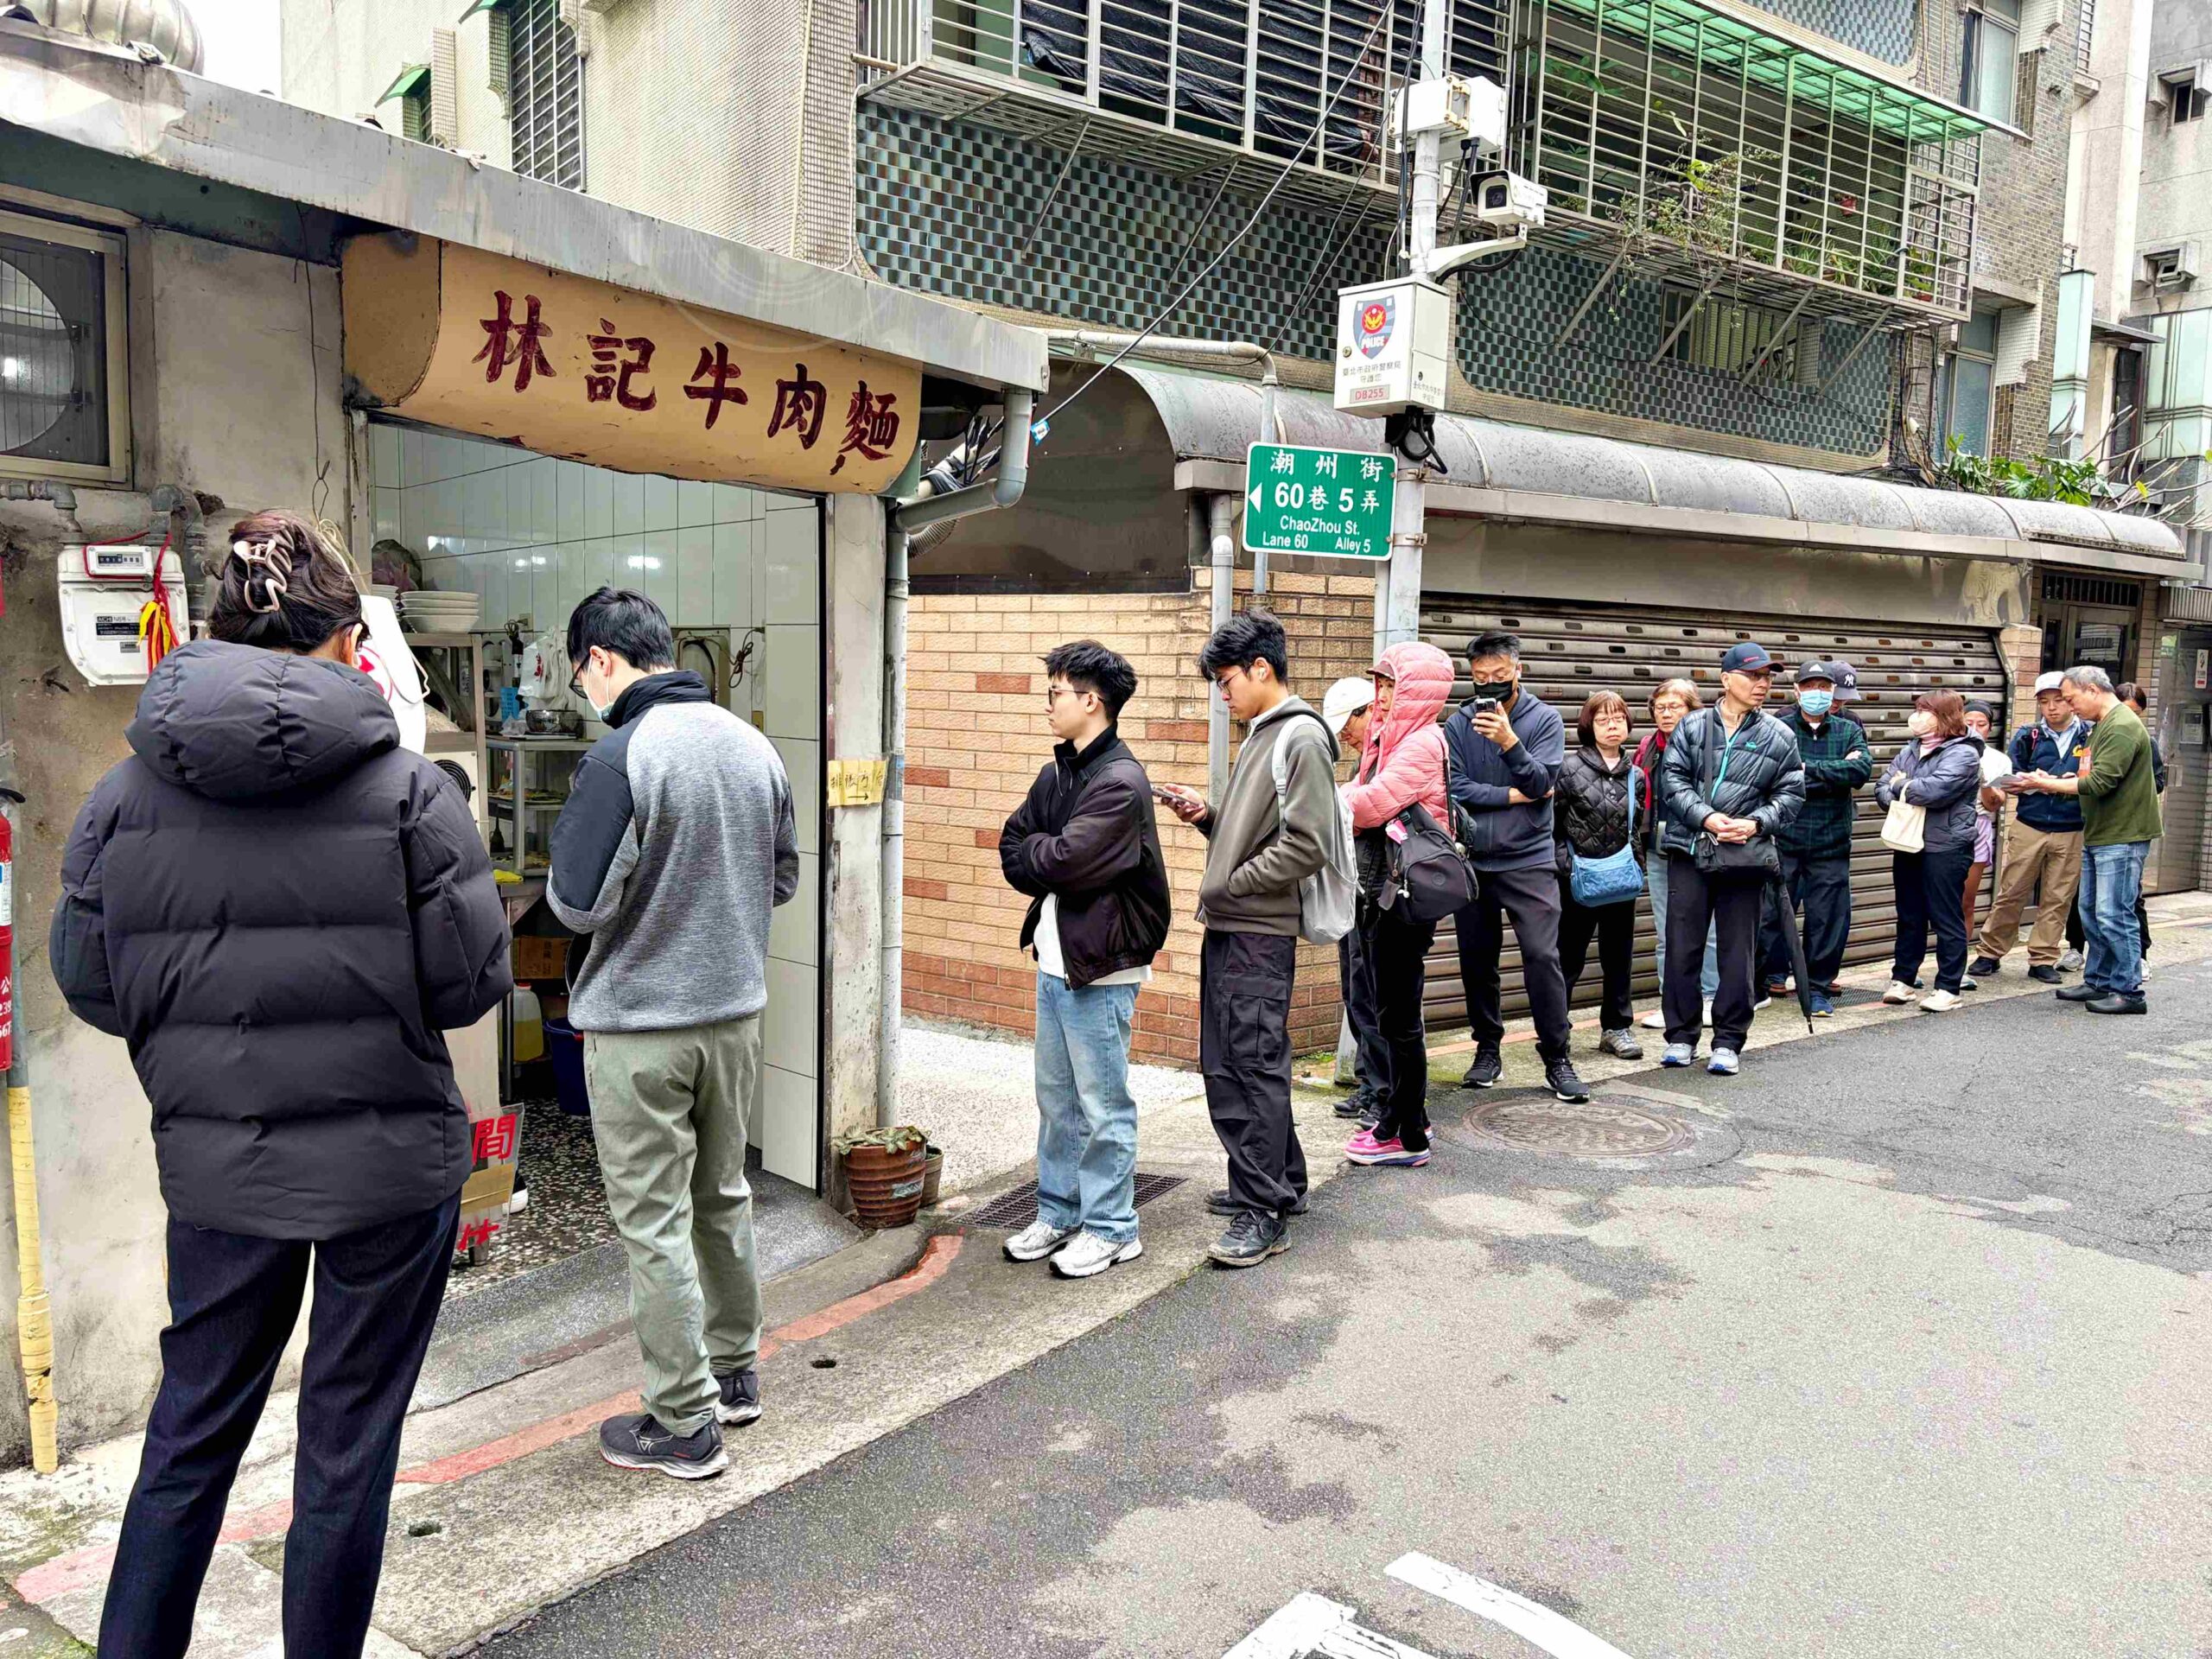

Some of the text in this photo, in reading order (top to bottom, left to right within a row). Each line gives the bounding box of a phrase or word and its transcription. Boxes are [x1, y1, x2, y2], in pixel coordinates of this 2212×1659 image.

[1360, 336, 1385, 349] POLICE
[471, 289, 900, 475] 林記牛肉麵
[1355, 389, 1384, 400] DB255
[1270, 448, 1384, 483] 潮州街
[1280, 514, 1360, 536] ChaoZhou St.
[1262, 531, 1371, 555] Lane 60 Alley 5
